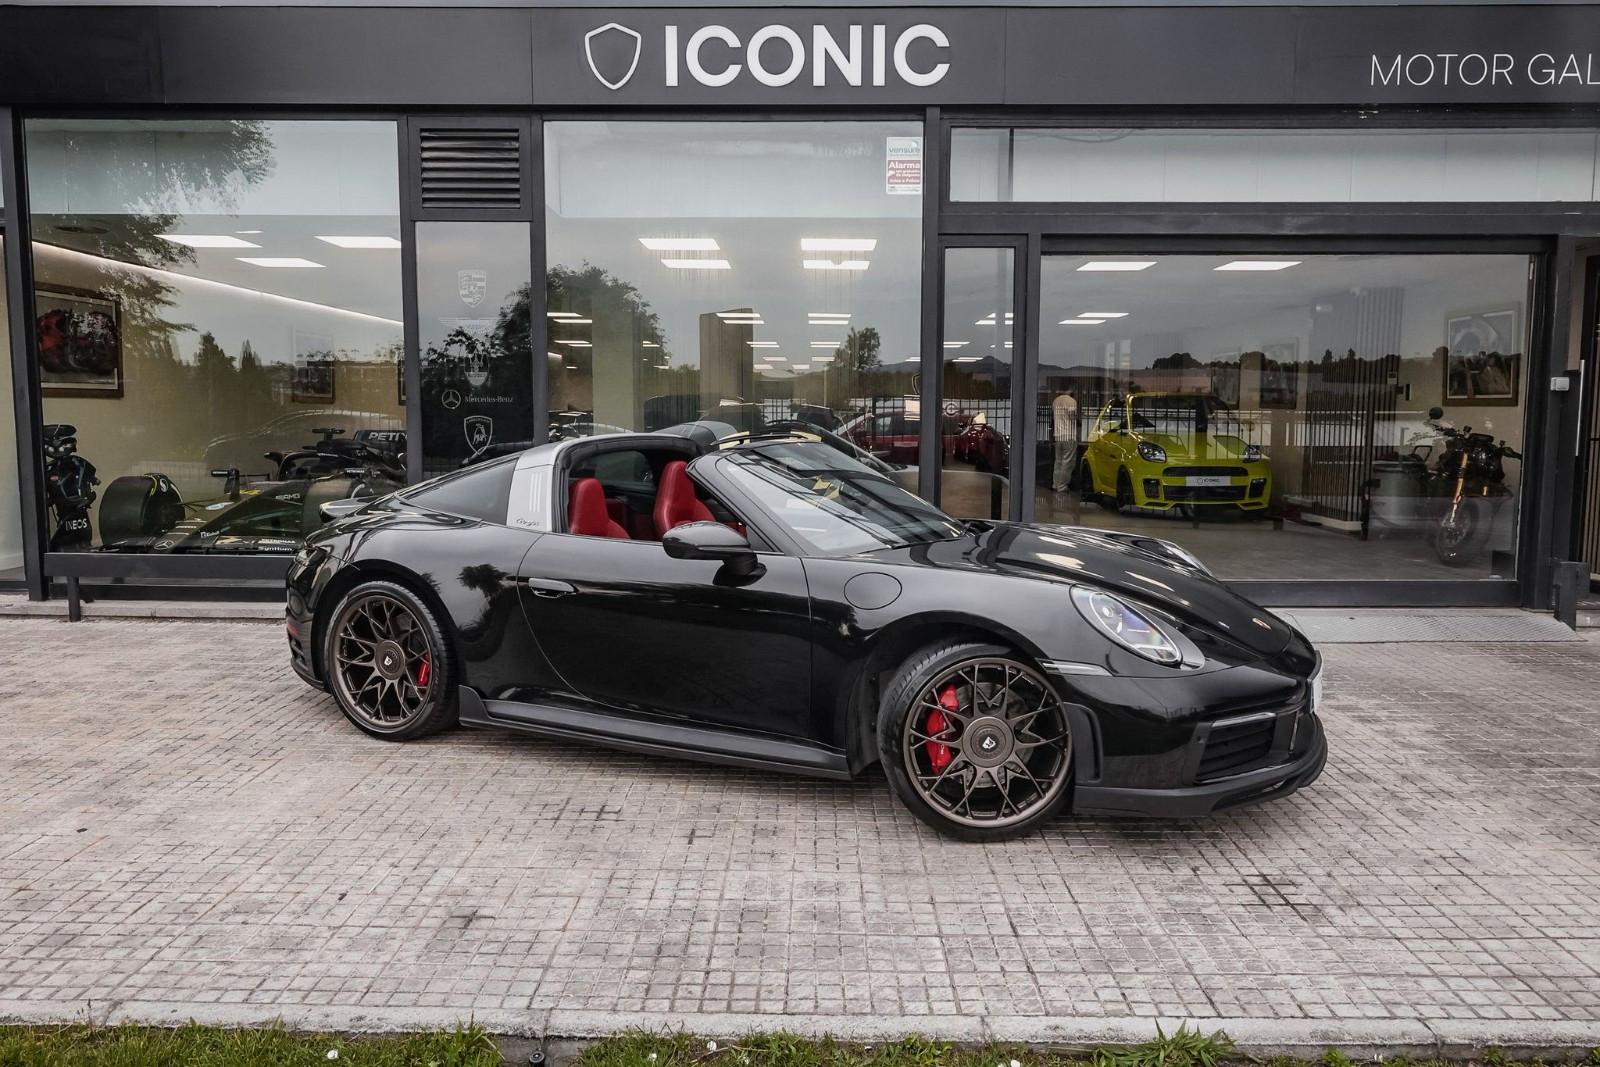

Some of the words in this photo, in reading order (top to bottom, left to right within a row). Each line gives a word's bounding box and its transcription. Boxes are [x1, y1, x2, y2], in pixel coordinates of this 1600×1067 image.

[664, 24, 950, 87] ICONIC
[1370, 53, 1514, 86] MOTOR
[1527, 53, 1600, 86] GAL
[464, 395, 513, 403] Mercedes-Benz
[65, 518, 88, 531] INEOS
